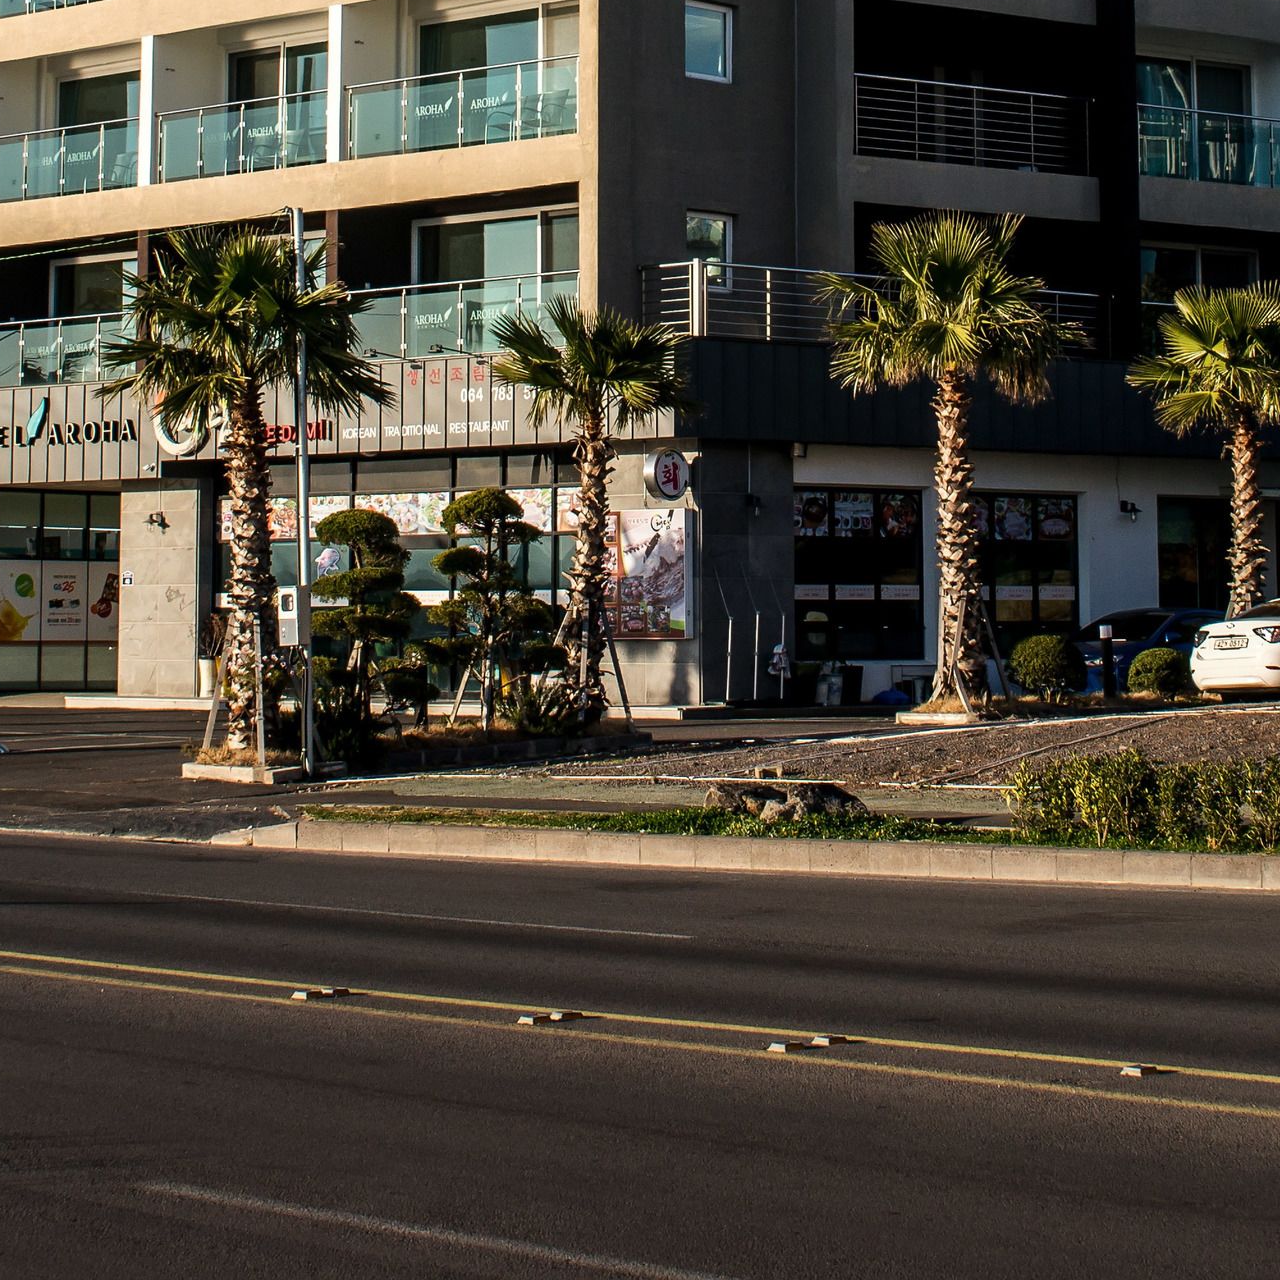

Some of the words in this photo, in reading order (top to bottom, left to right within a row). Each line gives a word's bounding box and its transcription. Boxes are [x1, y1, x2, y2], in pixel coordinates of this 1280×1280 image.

[415, 103, 444, 117] AROHA
[471, 97, 500, 110] AROHA
[247, 126, 274, 138] AROHA
[66, 151, 92, 163] AROHA
[414, 313, 444, 325] AROHA
[470, 308, 500, 321] AROHA
[460, 387, 483, 403] 064
[47, 419, 137, 446] AROHA
[342, 426, 377, 440] KOREAN
[384, 423, 441, 437] TRADITIONAL
[449, 420, 510, 434] RESTAURANT
[661, 462, 679, 491] 회
